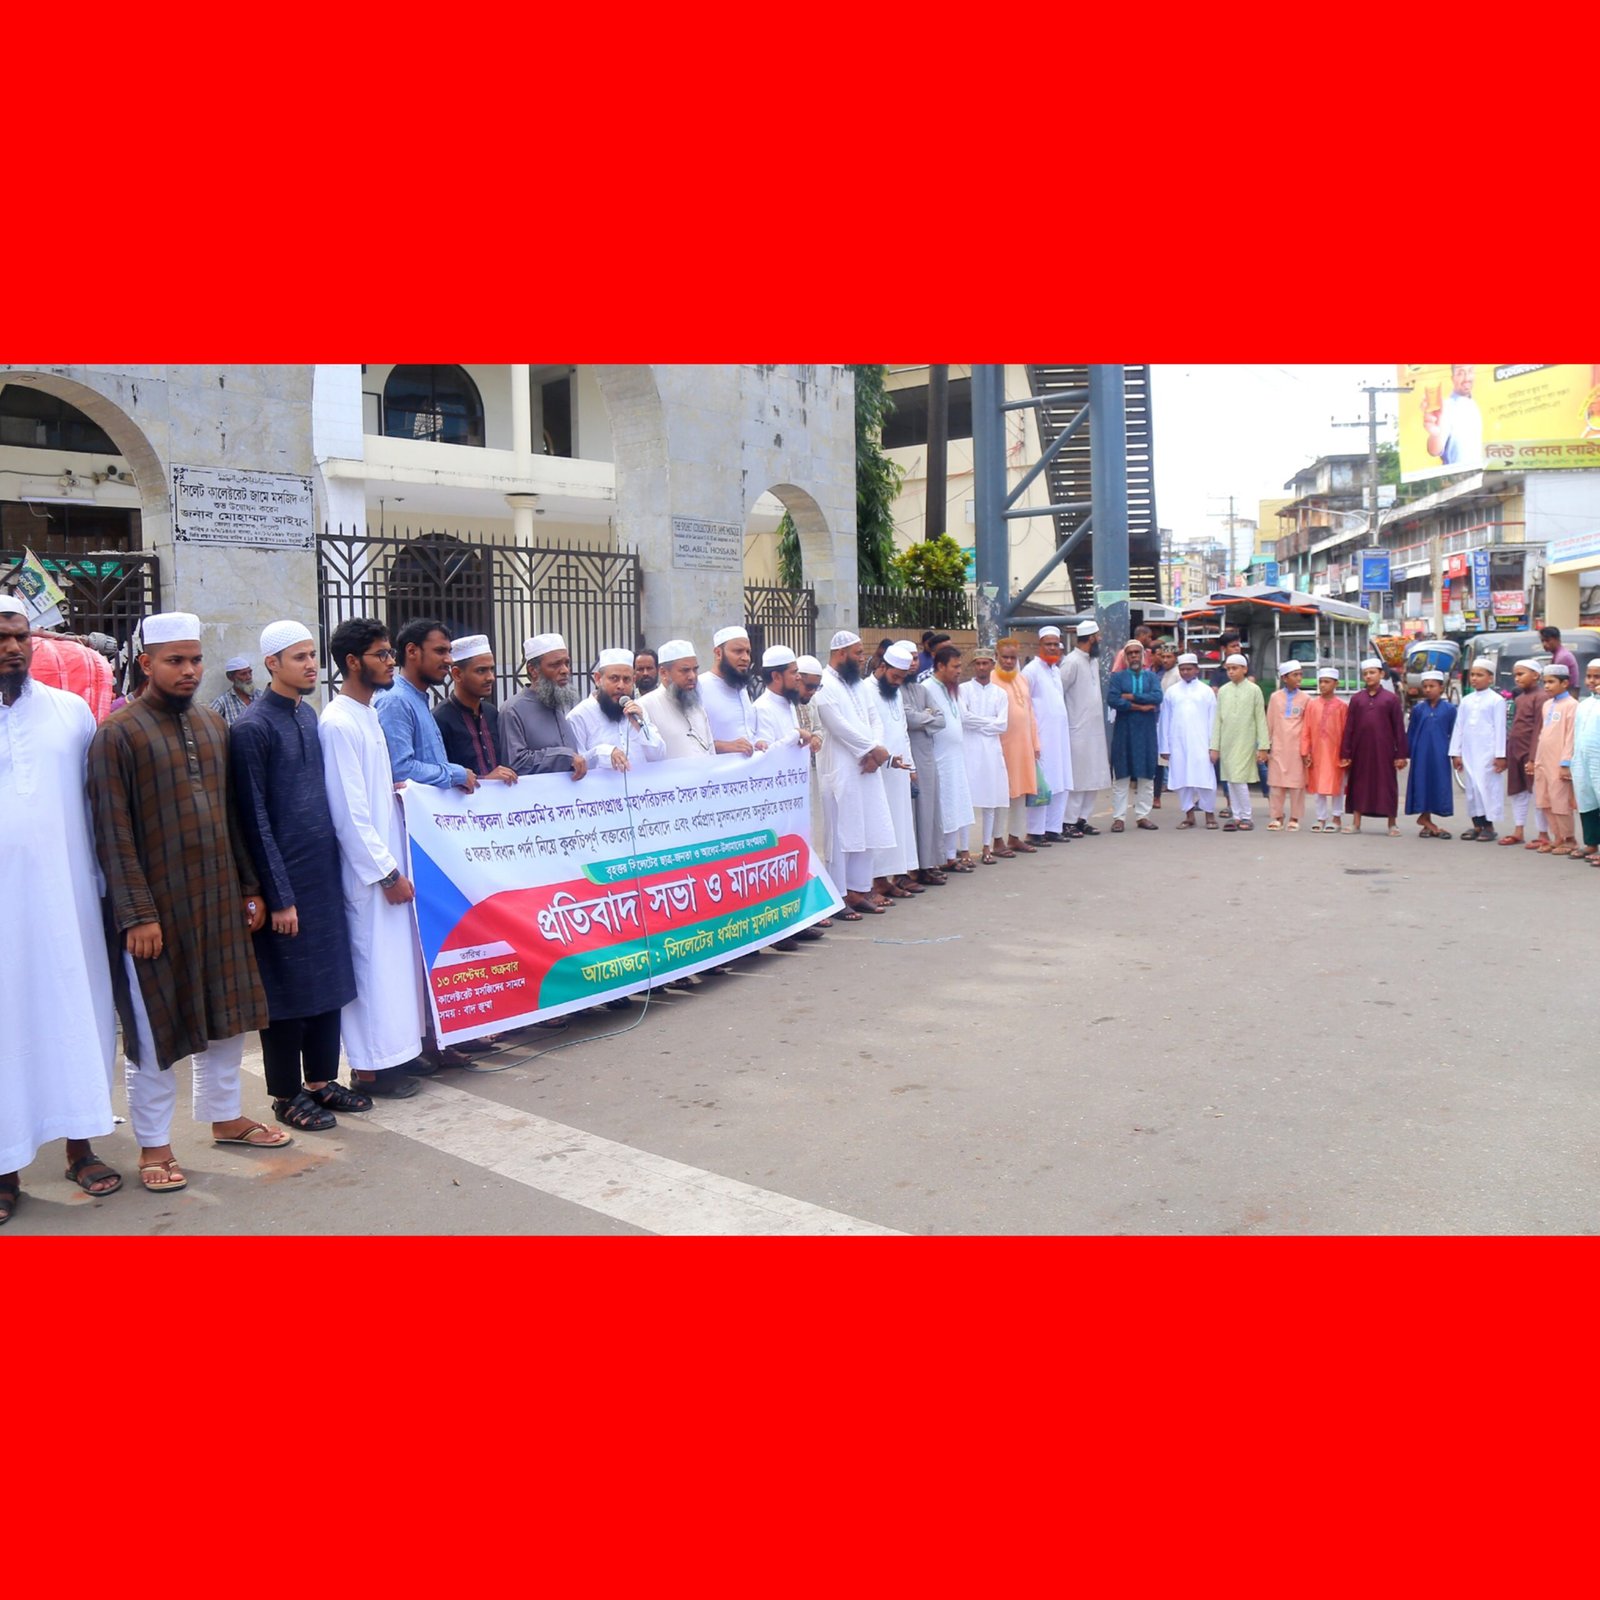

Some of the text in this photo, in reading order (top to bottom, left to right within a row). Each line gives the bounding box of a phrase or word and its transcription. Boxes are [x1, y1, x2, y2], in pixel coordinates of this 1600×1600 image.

[179, 480, 206, 498] সিলেট
[249, 489, 269, 503] জামে
[270, 489, 298, 504] মসজিদ
[180, 509, 214, 520] জনাব
[433, 813, 468, 831] বাংলাদেশ
[556, 804, 575, 821] সদ্য
[536, 834, 556, 856] নিয়ে
[637, 818, 671, 840] প্রতিবাদে
[673, 819, 690, 834] এবং
[627, 856, 659, 873] সিলেটের
[536, 849, 801, 946] প্রতিবাদ সভা ও মানববন্ধন
[581, 949, 649, 984] আয়োজনে
[663, 929, 714, 962] সিলেটের
[717, 916, 750, 943] ধর্মপ্রাণ
[751, 905, 779, 936] মুসলিম
[780, 897, 801, 919] জনতা
[437, 976, 450, 988] ১৩
[474, 982, 505, 997] মসজিদের
[505, 977, 526, 989] সামনে
